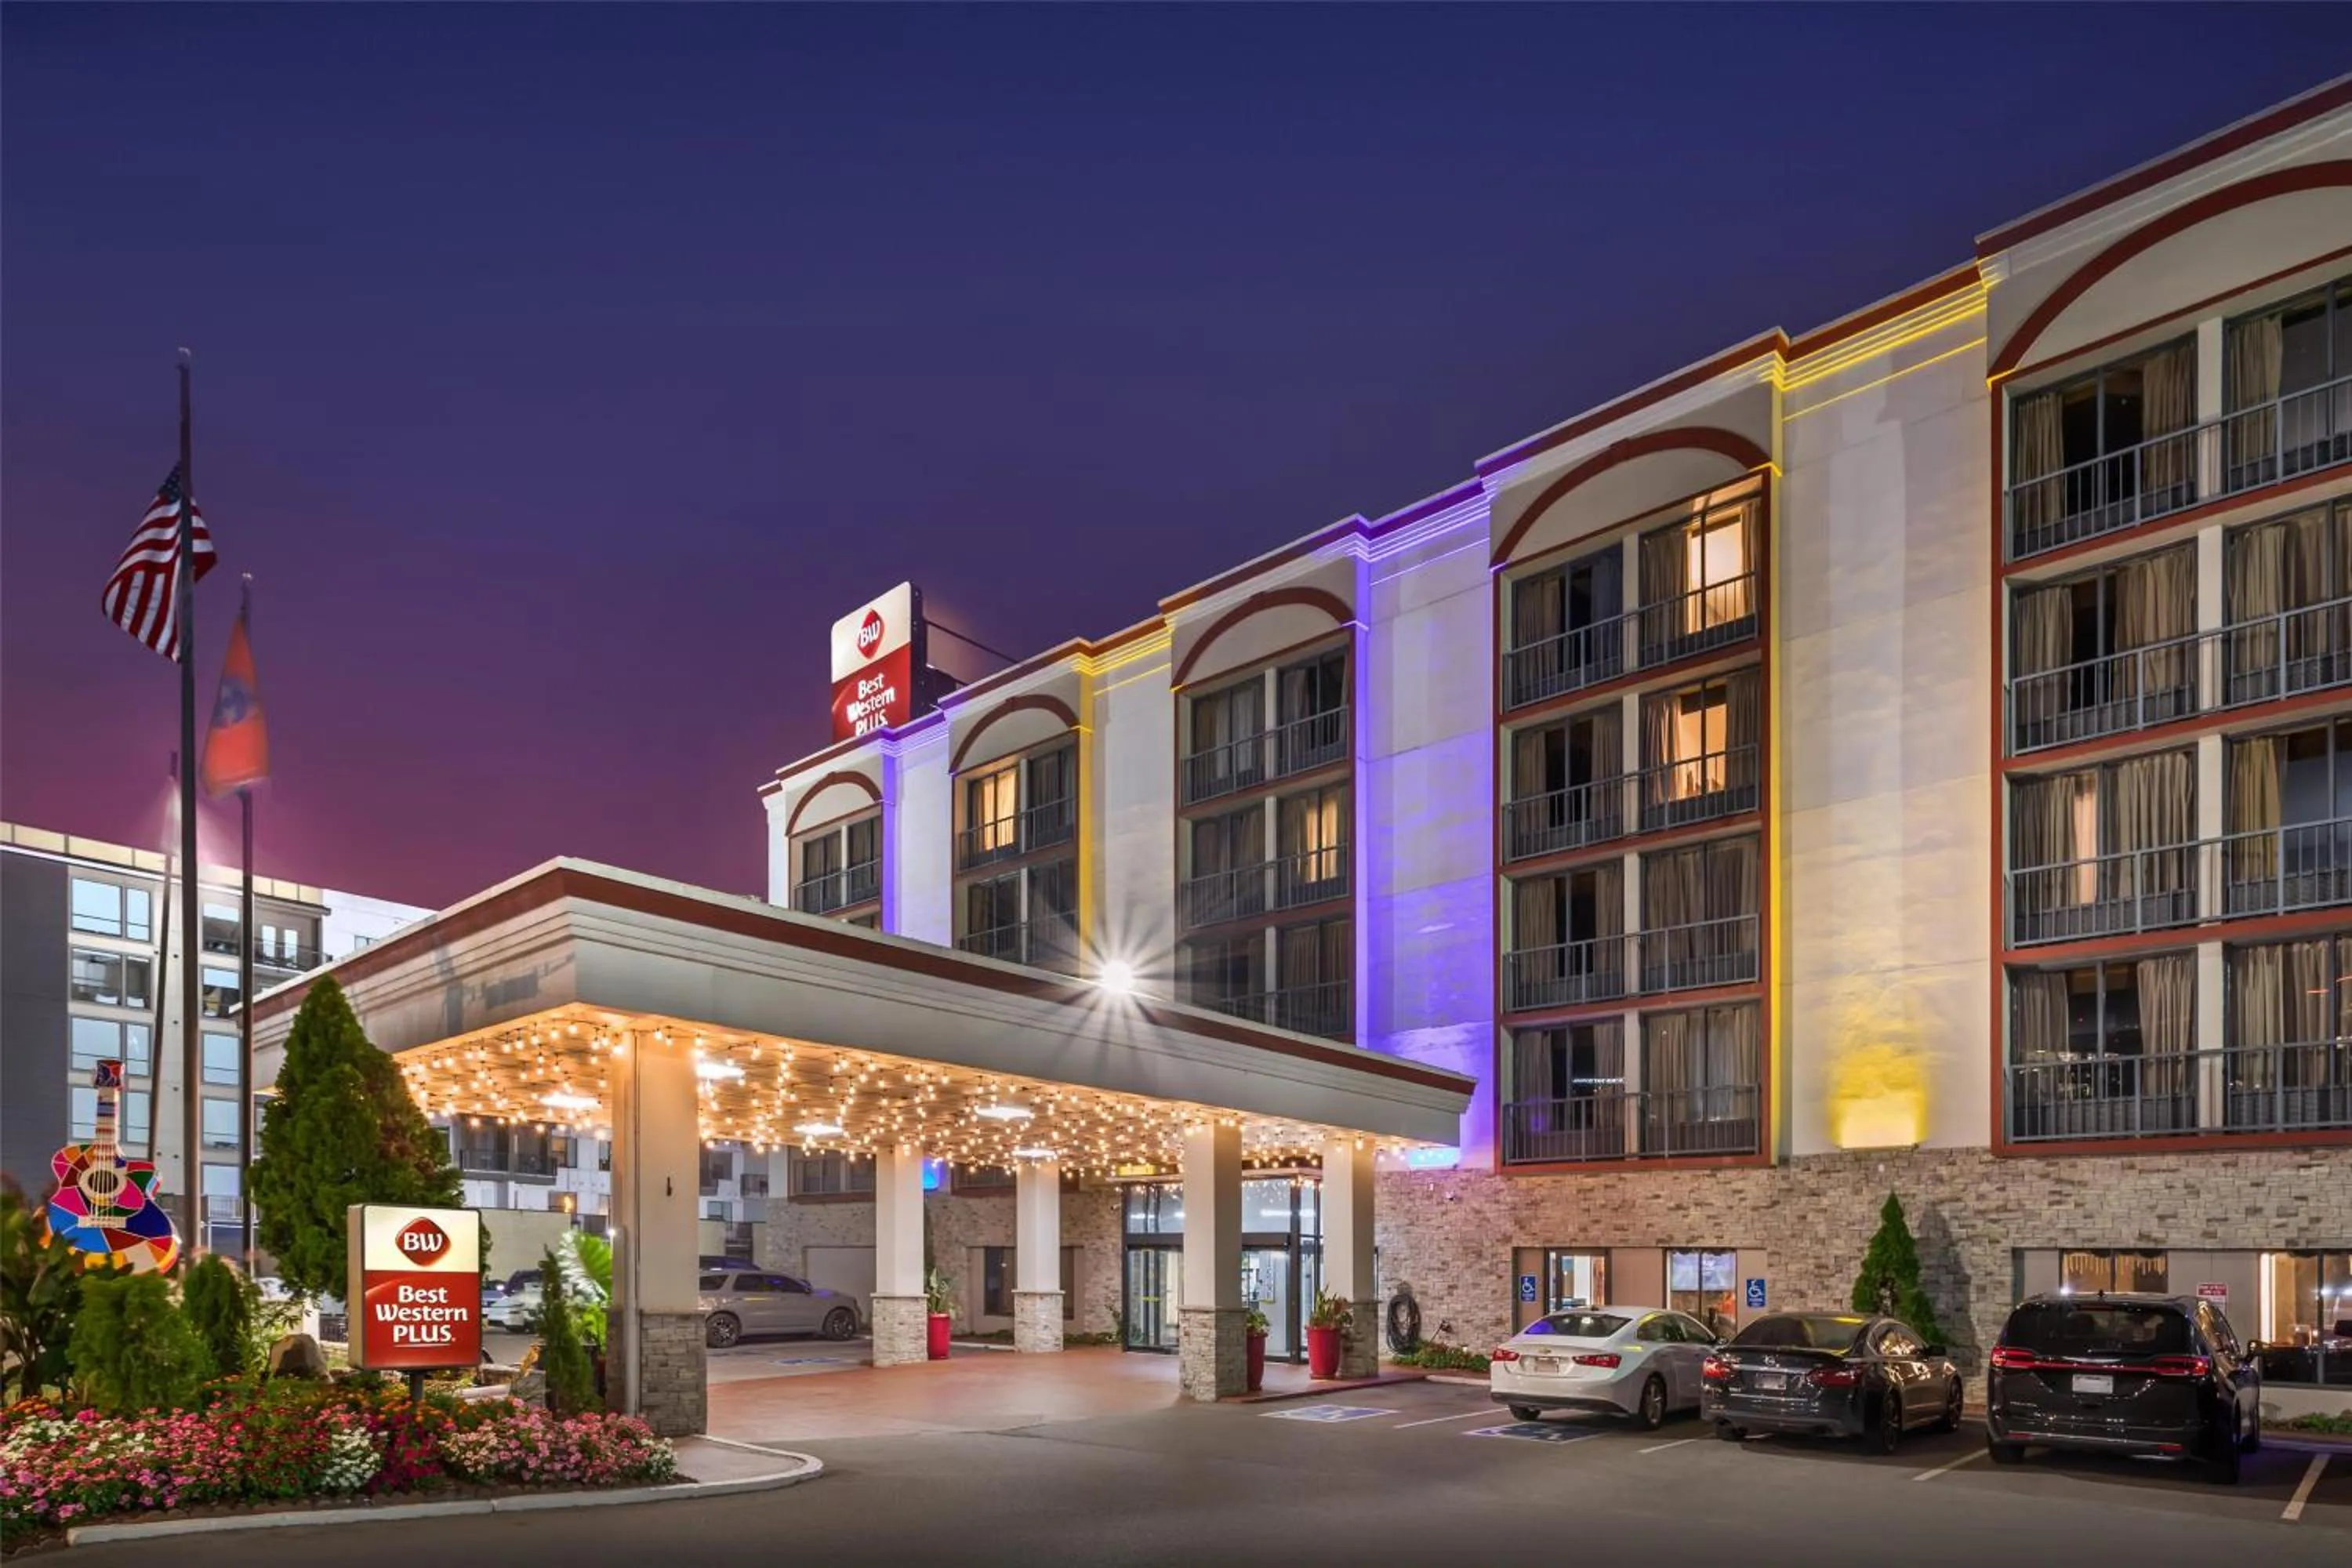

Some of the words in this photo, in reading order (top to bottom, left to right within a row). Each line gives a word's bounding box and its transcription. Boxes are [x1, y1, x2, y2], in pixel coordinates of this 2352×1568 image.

[859, 620, 880, 648] BW
[858, 673, 884, 699] Best
[847, 686, 895, 723] Western
[404, 1232, 443, 1251] BW
[398, 1285, 448, 1303] Best
[376, 1304, 468, 1321] Western
[393, 1324, 452, 1342] PLUS
